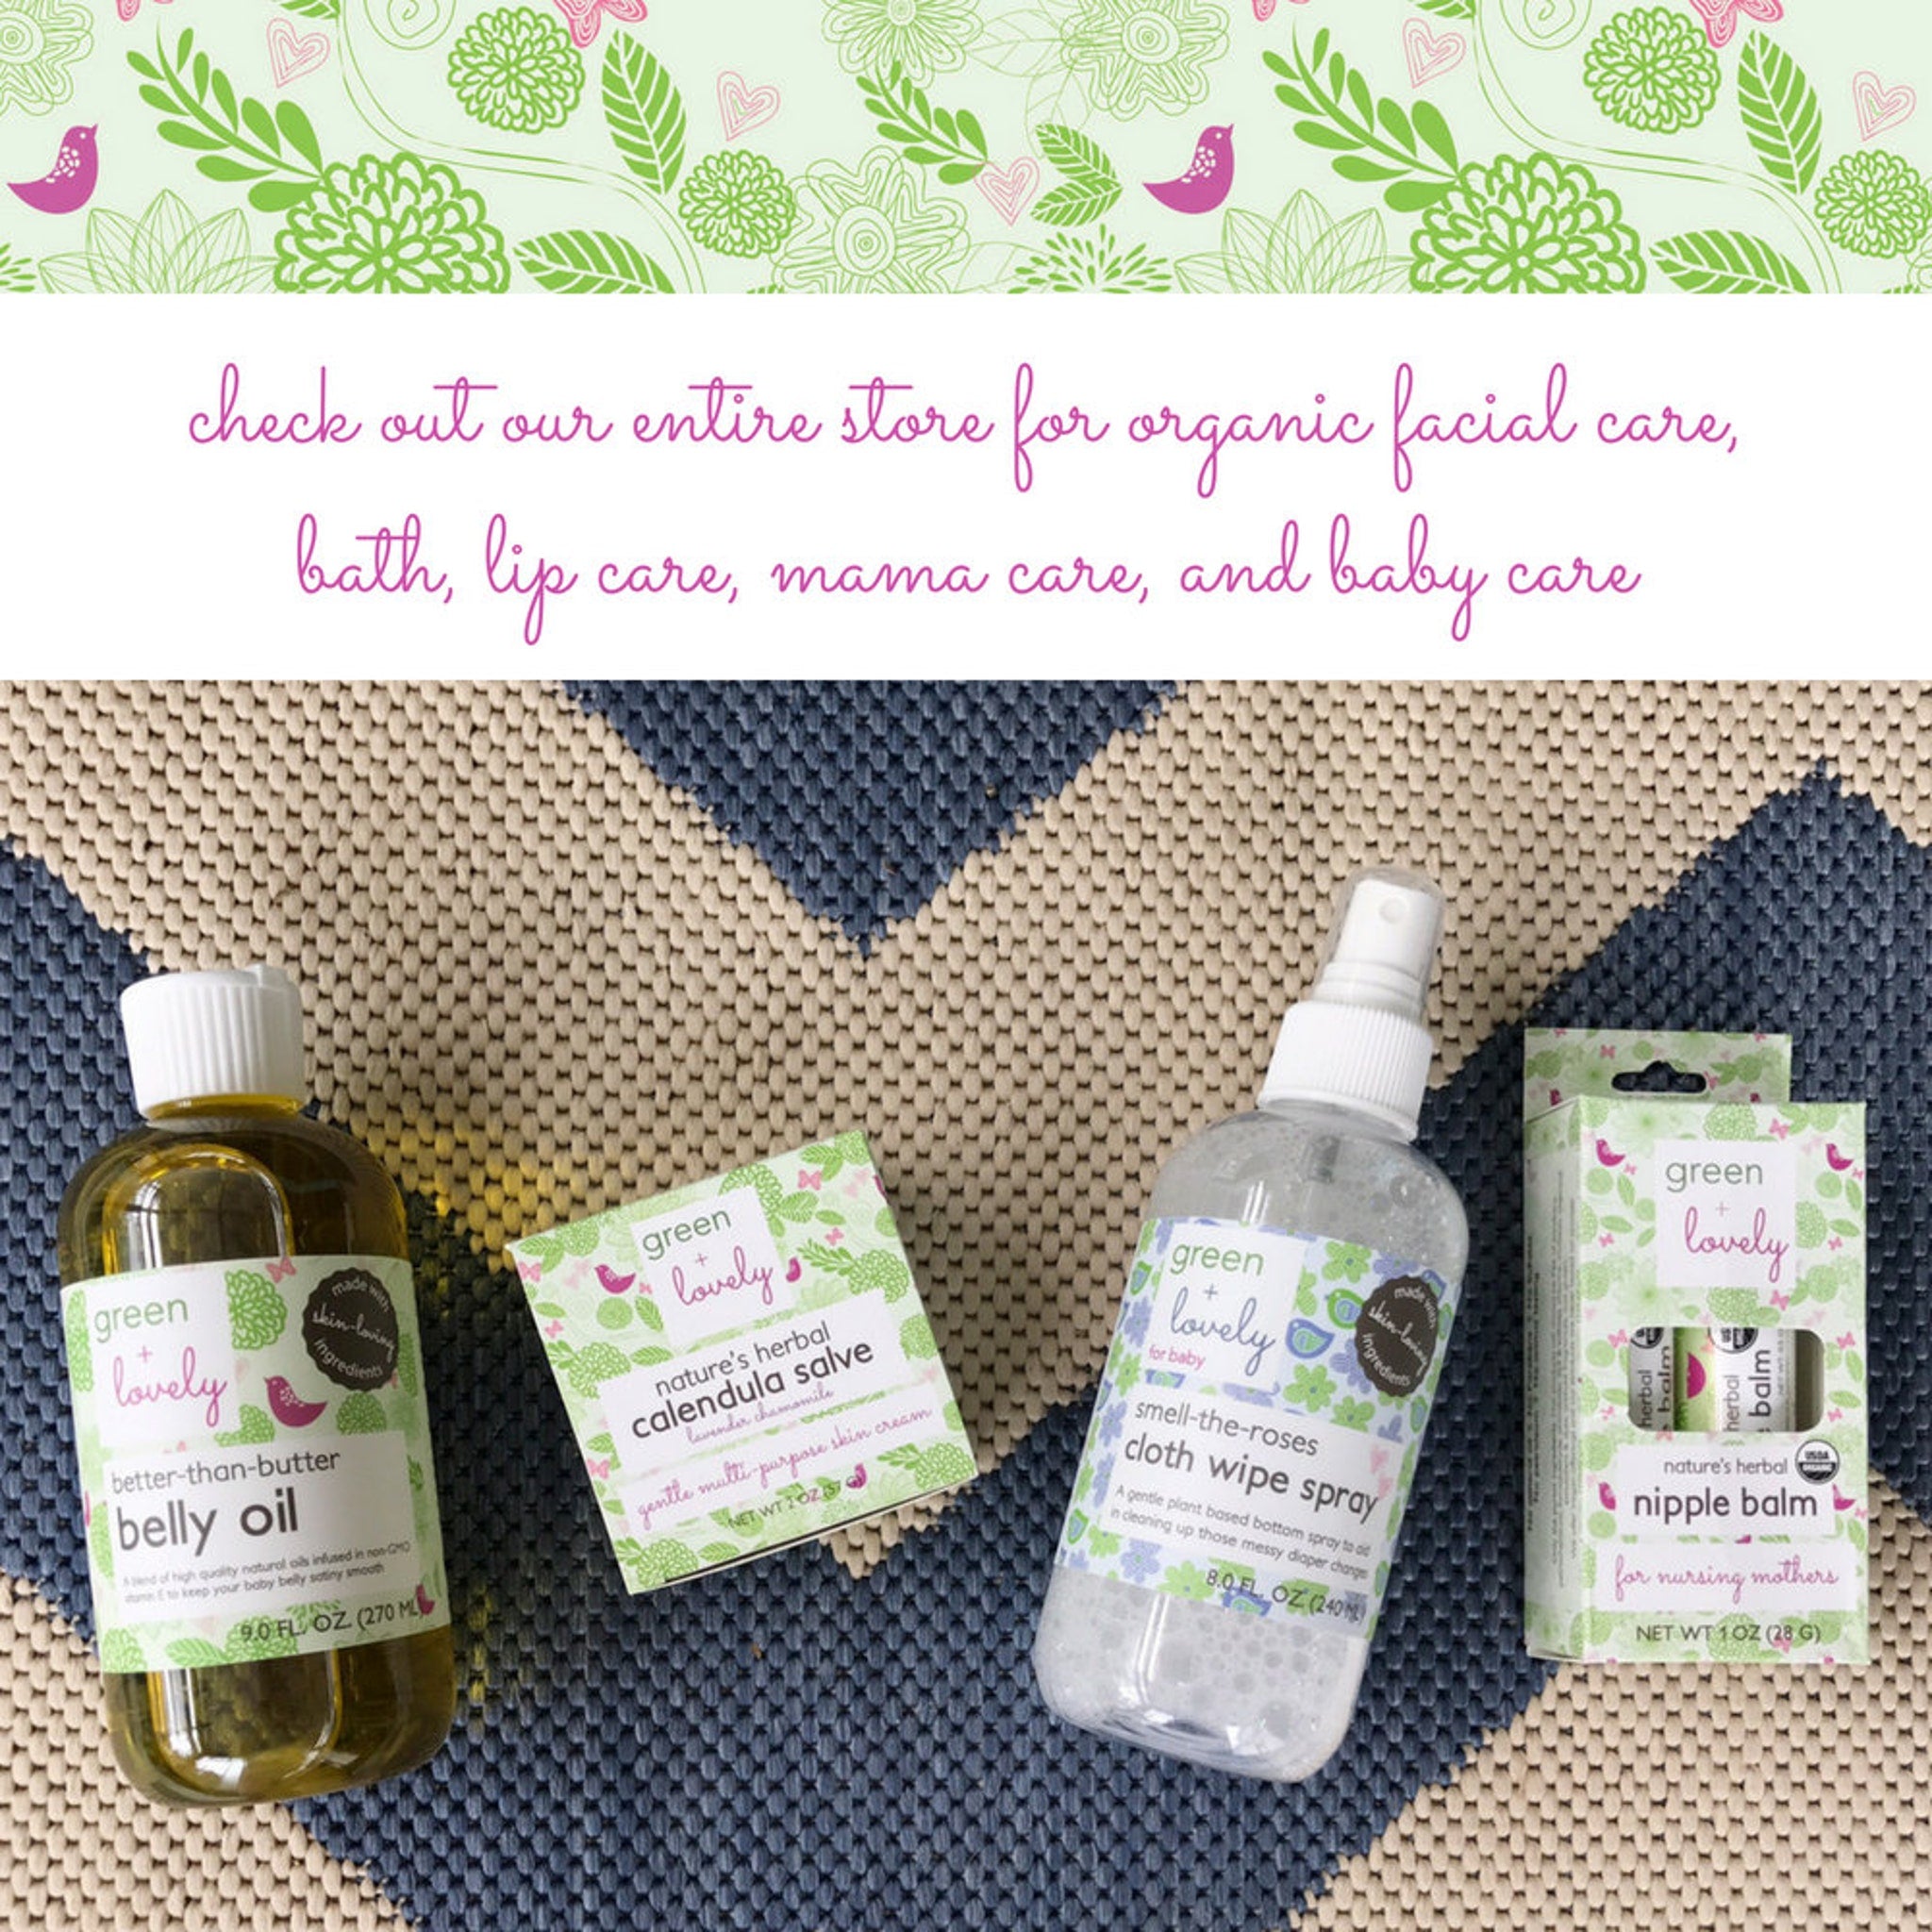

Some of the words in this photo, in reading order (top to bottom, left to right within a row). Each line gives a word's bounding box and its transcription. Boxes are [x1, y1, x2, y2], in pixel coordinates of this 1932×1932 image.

[1665, 1162, 1763, 1192] green
[642, 1209, 731, 1260] green
[1170, 1243, 1264, 1275] green
[1685, 1206, 1790, 1283] lovely
[332, 1275, 368, 1296] made
[369, 1284, 389, 1312] with
[672, 1245, 774, 1306] lovely
[1394, 1287, 1425, 1302] made
[94, 1299, 188, 1343] green
[312, 1303, 394, 1363] skin-loving
[1171, 1286, 1275, 1376] lovely
[1368, 1301, 1427, 1377] skin-loving
[314, 1338, 383, 1378] ingredients
[656, 1350, 749, 1397] nature's
[754, 1320, 830, 1363] herbal
[1149, 1343, 1166, 1360] for
[1168, 1346, 1206, 1370] baby
[1362, 1332, 1410, 1387] ingredients
[1657, 1345, 1673, 1412] balm
[1748, 1349, 1772, 1417] balm
[113, 1346, 227, 1427] lovely
[632, 1370, 785, 1439] calendula
[794, 1342, 874, 1385] salve
[686, 1413, 752, 1444] lavender
[755, 1381, 833, 1423] chamomile
[1638, 1368, 1652, 1429] herbal
[1724, 1374, 1740, 1432] herbal
[1135, 1401, 1319, 1456] smell-the-roses
[1805, 1450, 1829, 1459] USDA
[112, 1450, 341, 1494] better-than-butter
[638, 1478, 694, 1530] gentle
[698, 1441, 826, 1494] multi-purpose
[831, 1425, 871, 1450] skin
[874, 1407, 931, 1435] cream
[1124, 1432, 1194, 1472] cloth
[1209, 1454, 1289, 1495] wipe
[1300, 1477, 1378, 1524] spray
[1663, 1457, 1731, 1475] nature's
[1736, 1457, 1788, 1475] herbal
[117, 1500, 217, 1557] belly
[241, 1488, 298, 1537] oil
[728, 1510, 756, 1528] NET
[758, 1500, 783, 1517] WT
[797, 1488, 820, 1505] OZ
[1116, 1485, 1124, 1497] A
[1127, 1490, 1164, 1507] gentle
[1167, 1496, 1203, 1515] plant
[1206, 1505, 1250, 1526] based
[1253, 1515, 1304, 1540] bottom
[1307, 1532, 1341, 1552] spray
[1343, 1540, 1354, 1553] to
[1634, 1486, 1730, 1525] nipple
[1741, 1487, 1818, 1517] balm
[1110, 1508, 1120, 1519] in
[1123, 1509, 1172, 1534] cleaning
[1175, 1524, 1193, 1539] up
[1199, 1526, 1237, 1546] those
[1241, 1539, 1284, 1561] messy
[1288, 1548, 1328, 1569] diaper
[171, 1570, 195, 1584] high
[199, 1565, 237, 1580] quality
[242, 1558, 286, 1574] natural
[312, 1552, 352, 1566] infused
[355, 1549, 364, 1558] in
[182, 1586, 210, 1600] keep
[213, 1583, 241, 1597] your
[244, 1577, 275, 1591] baby
[278, 1574, 306, 1588] belly
[346, 1562, 385, 1577] smooth
[1207, 1569, 1234, 1591] 8.0
[1240, 1576, 1264, 1599] FL.
[1272, 1585, 1305, 1608] OZ
[1615, 1554, 1651, 1602] for
[1657, 1565, 1745, 1605] nursing
[1751, 1555, 1839, 1585] mothers
[241, 1622, 271, 1642] 9.0
[277, 1619, 306, 1637] FL.
[357, 1603, 394, 1630] (270
[1636, 1624, 1674, 1641] NET
[1680, 1624, 1713, 1641] WT
[1719, 1624, 1727, 1641] 1
[1732, 1624, 1760, 1641] OZ
[1766, 1624, 1792, 1642] (28
[1799, 1624, 1822, 1642] G)
